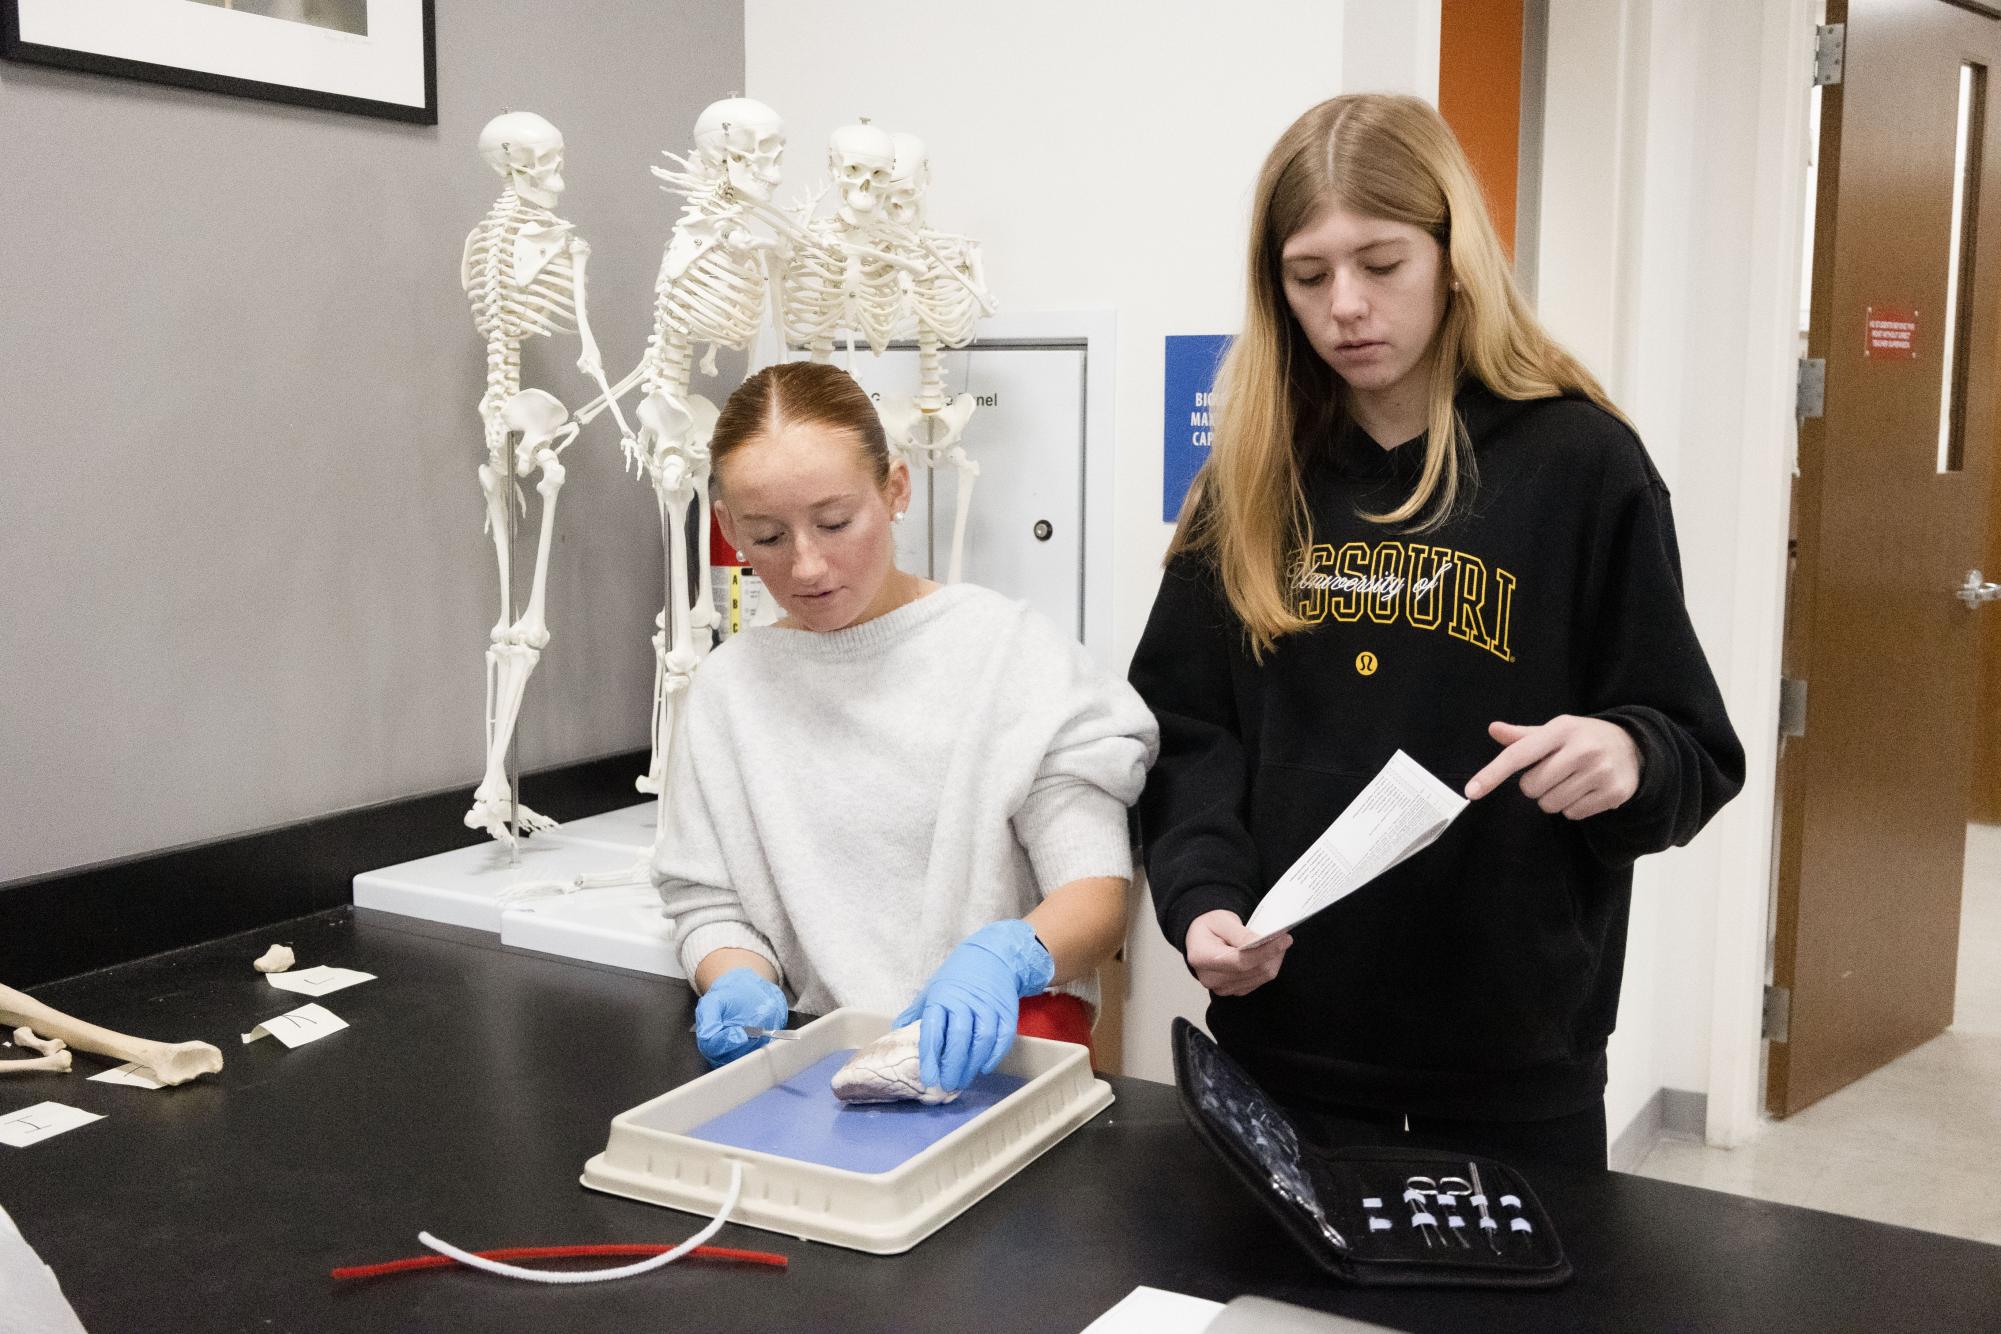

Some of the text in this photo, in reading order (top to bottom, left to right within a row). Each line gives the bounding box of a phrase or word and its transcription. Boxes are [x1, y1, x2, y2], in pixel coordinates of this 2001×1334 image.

[732, 574, 739, 585] A
[1286, 561, 1453, 601] University of
[732, 599, 739, 609] B
[732, 623, 739, 633] C
